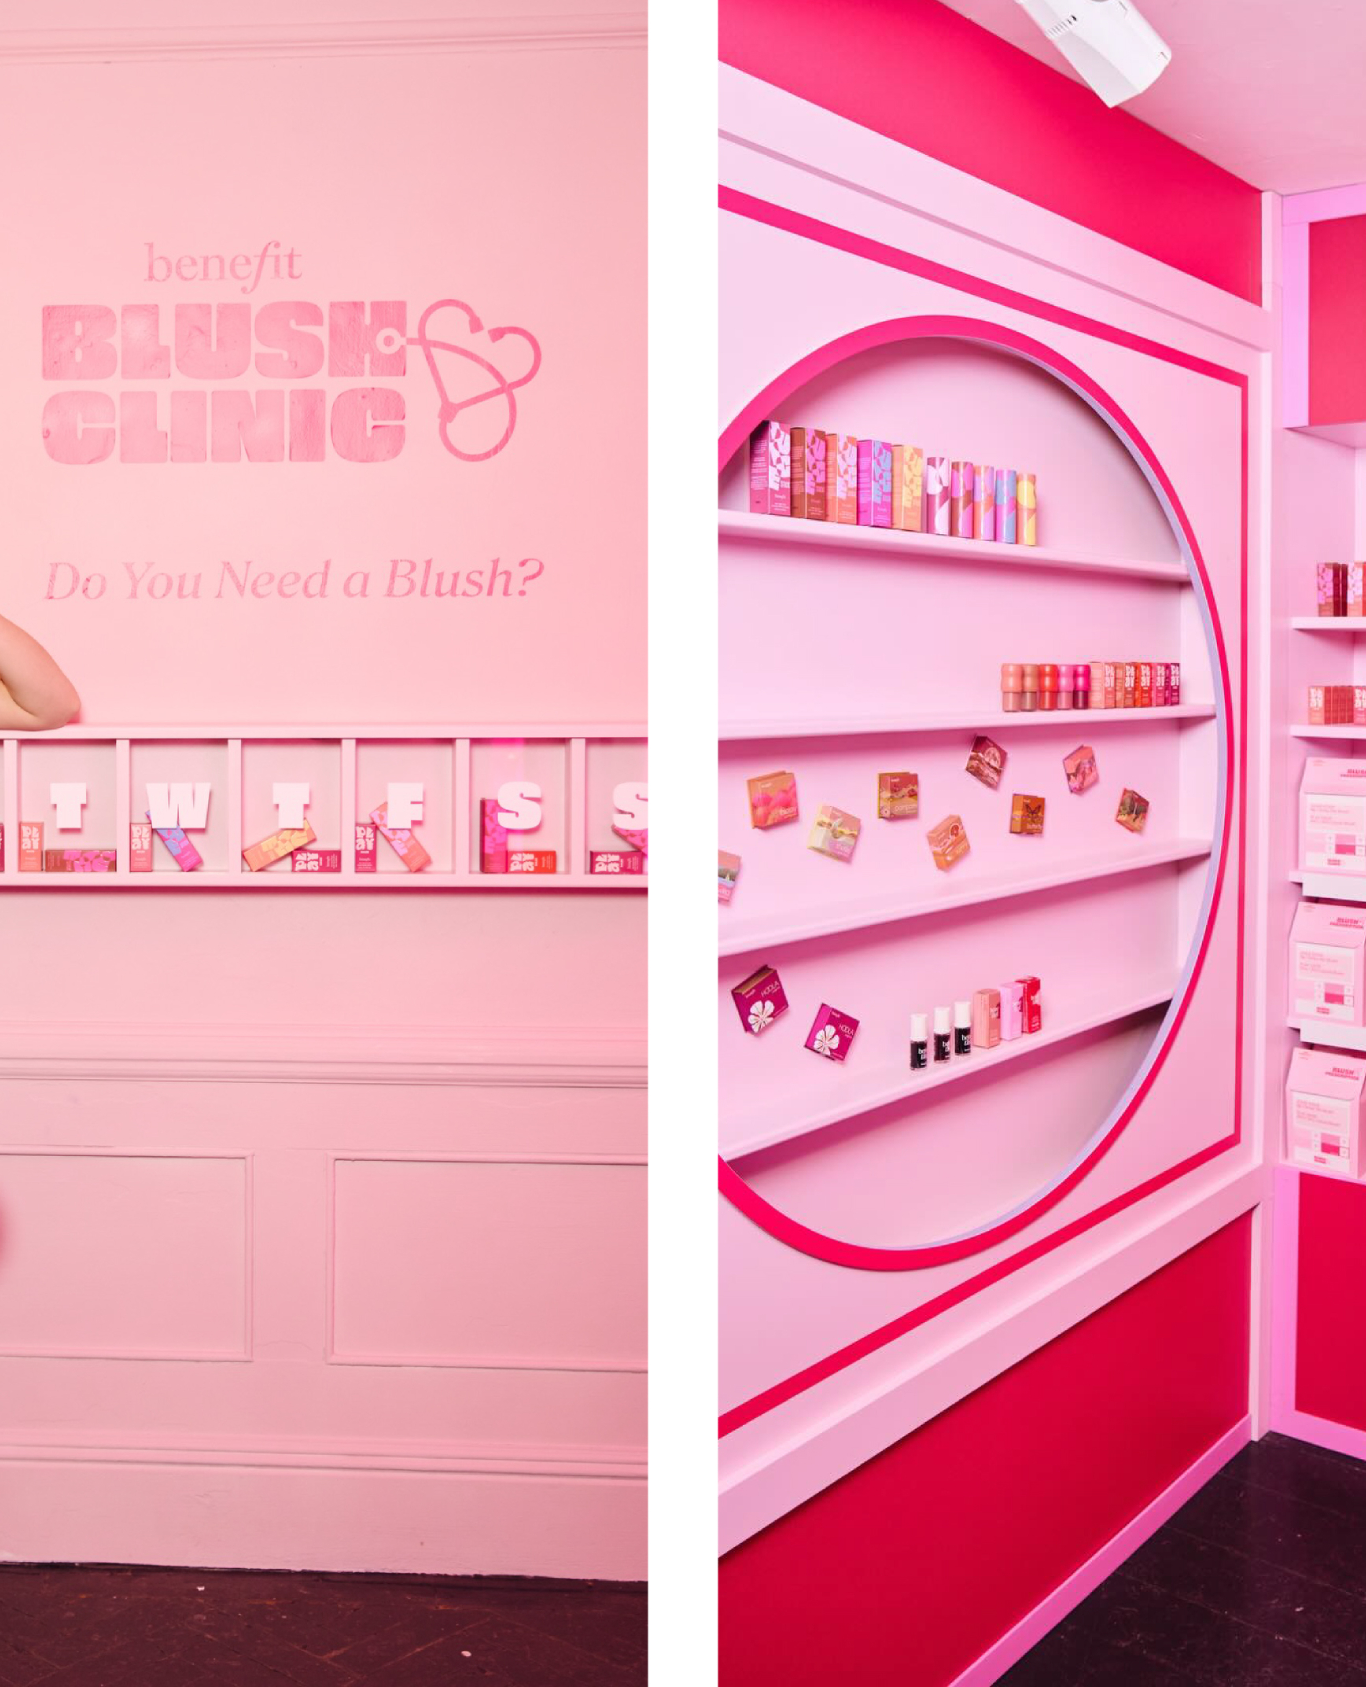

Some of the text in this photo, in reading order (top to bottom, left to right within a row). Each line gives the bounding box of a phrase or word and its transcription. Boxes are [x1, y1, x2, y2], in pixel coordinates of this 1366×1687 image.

[143, 240, 303, 295] benefit
[41, 301, 407, 381] BLUSH
[41, 387, 407, 465] CLINIC
[42, 556, 547, 600] Do You Need a Blush?
[49, 782, 87, 829] T
[145, 782, 212, 829] W
[272, 782, 310, 829] T
[387, 782, 424, 829] F
[497, 781, 543, 830] S
[612, 781, 648, 831] S
